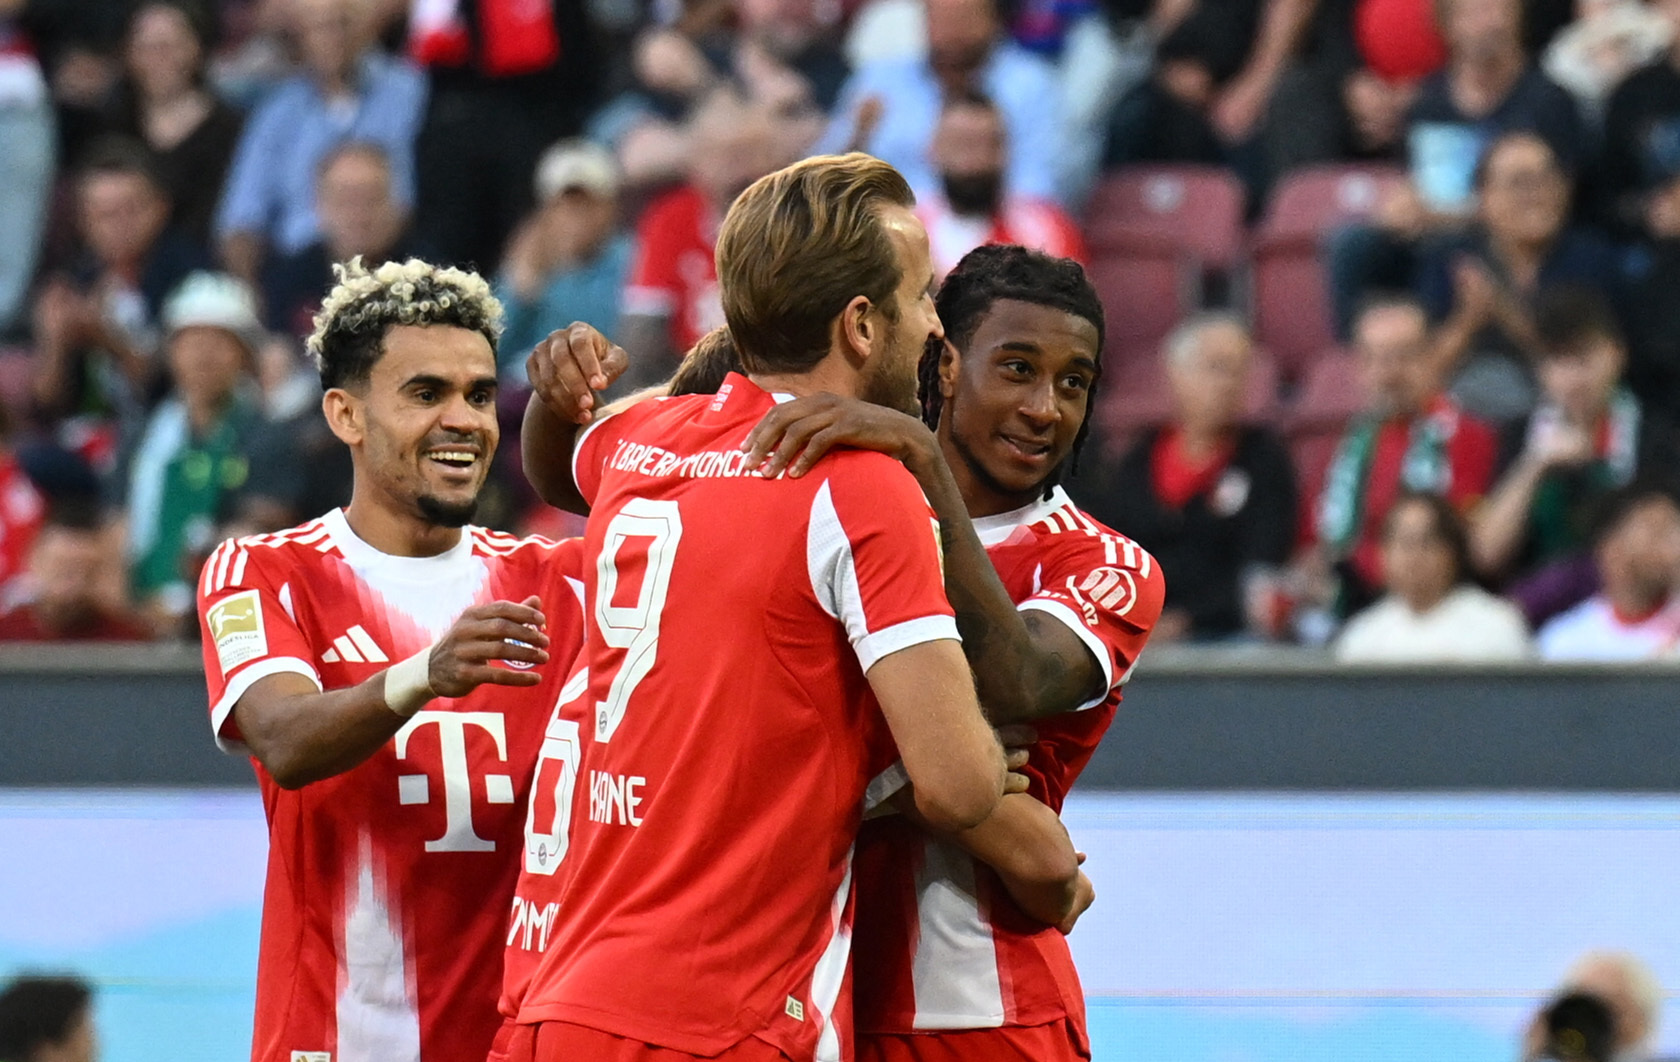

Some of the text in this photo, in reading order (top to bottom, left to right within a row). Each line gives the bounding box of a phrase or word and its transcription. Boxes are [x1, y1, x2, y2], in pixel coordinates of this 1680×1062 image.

[595, 497, 683, 744] 9
[394, 710, 514, 853] T
[524, 666, 588, 875] 6
[589, 770, 646, 827] KANE
